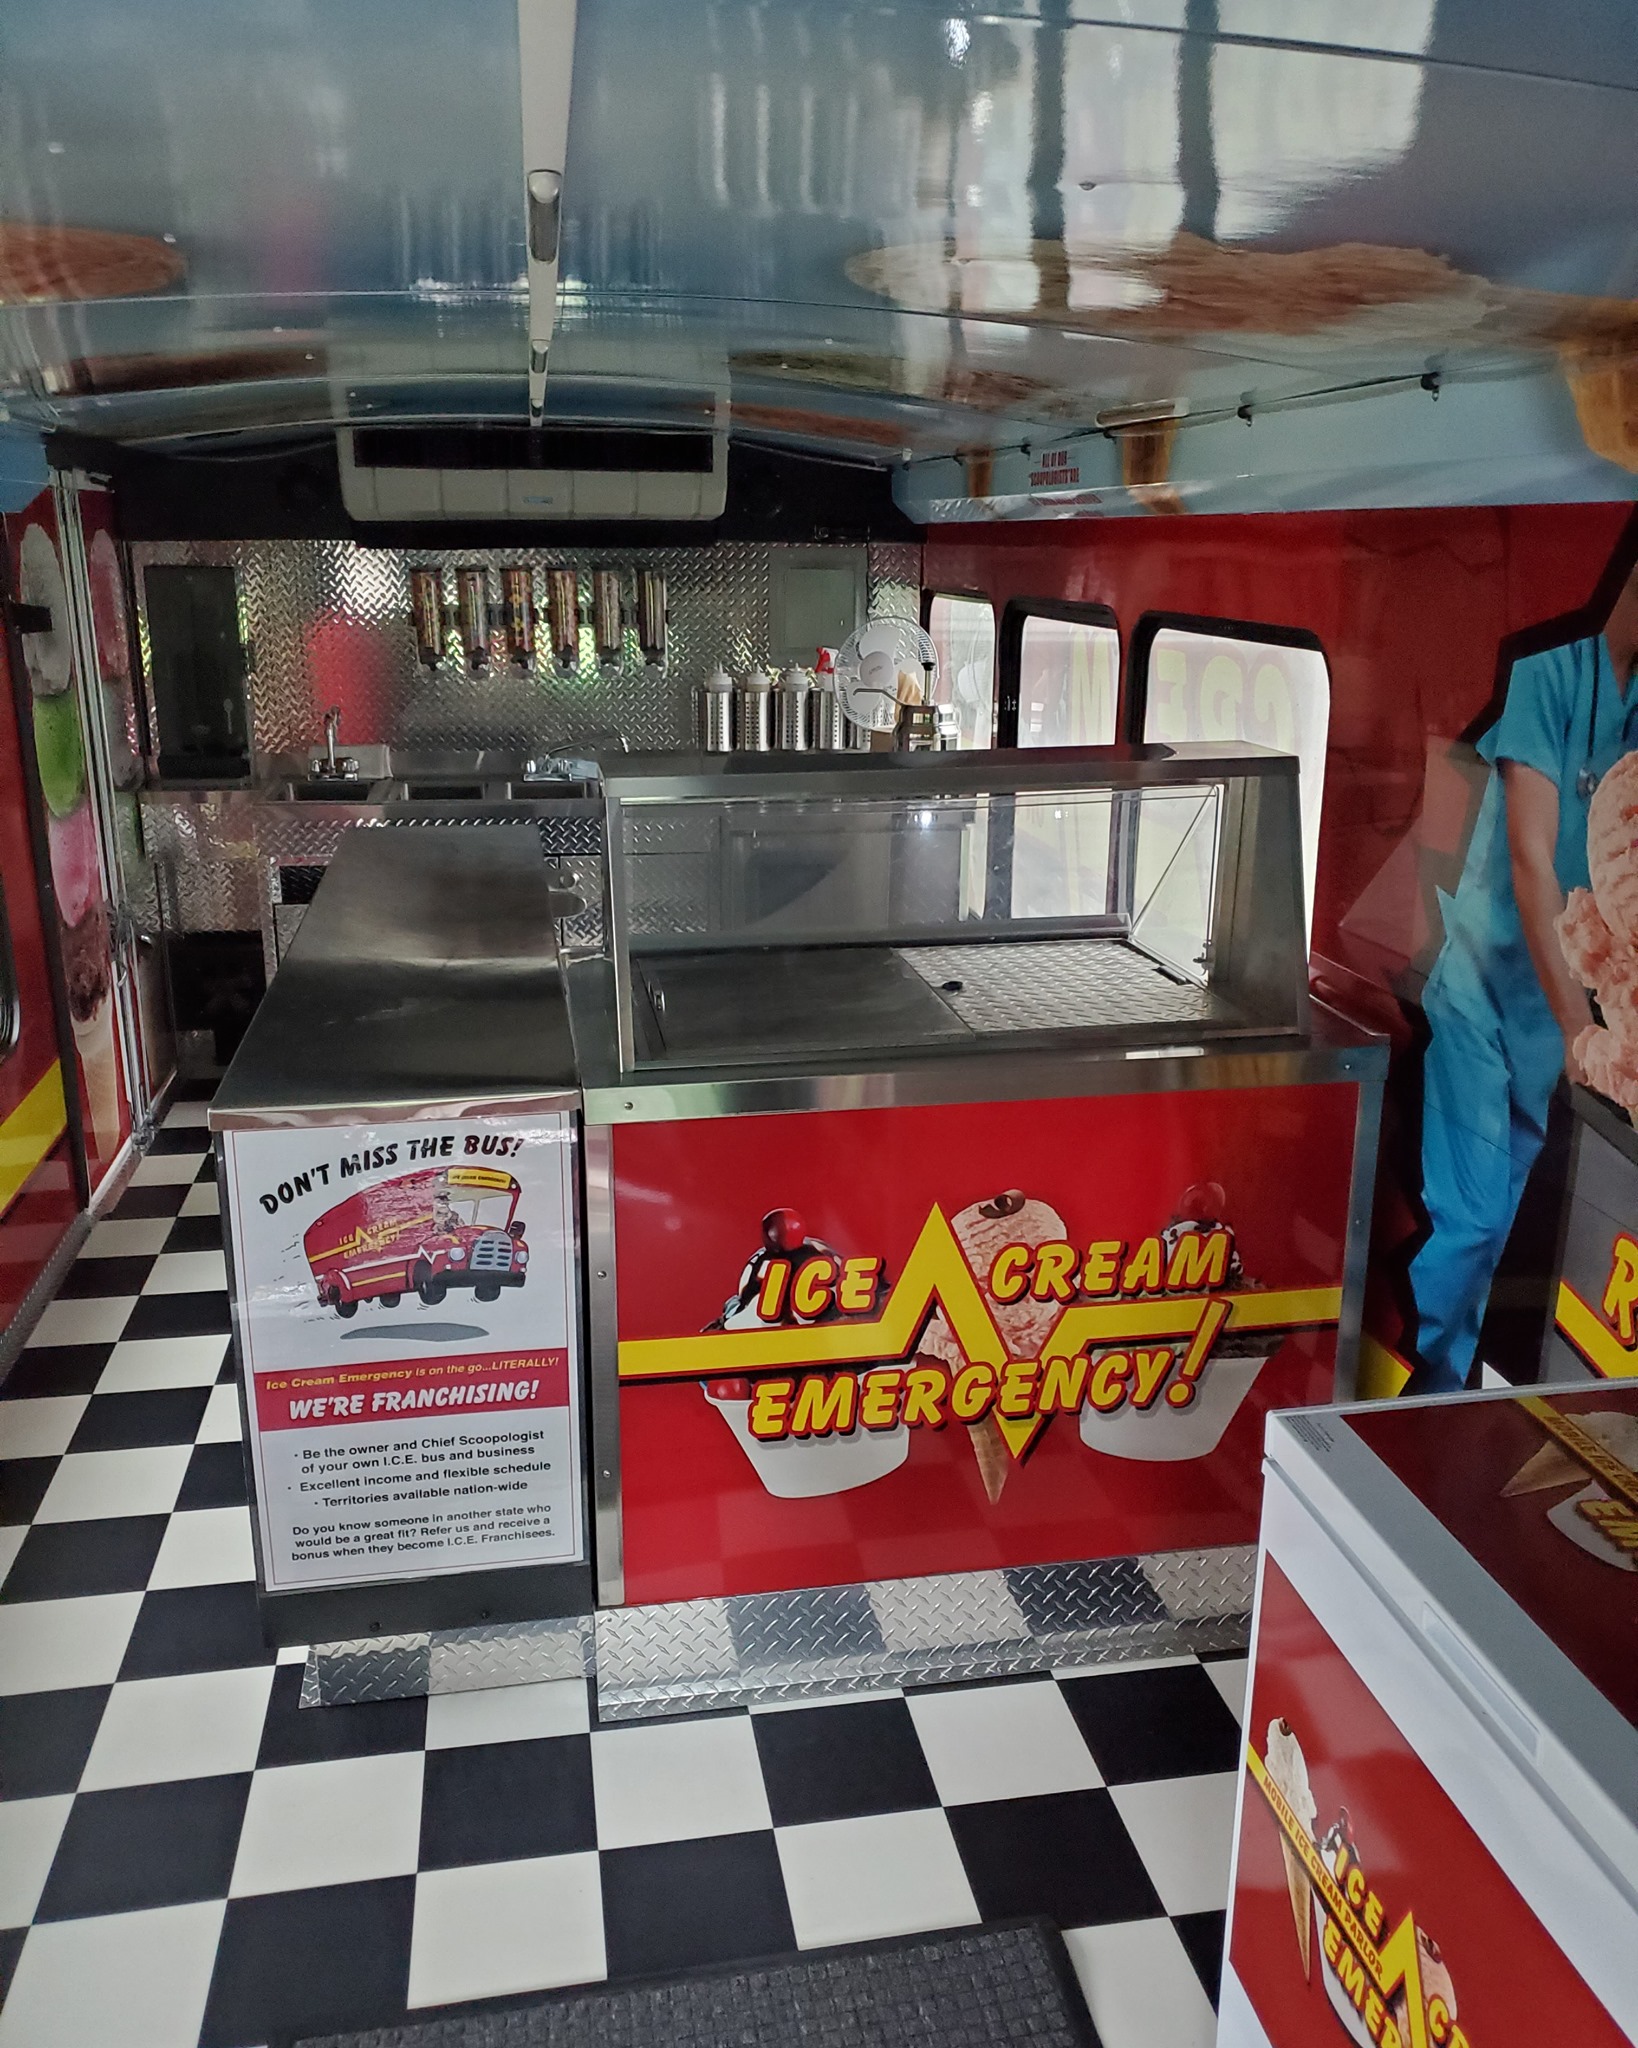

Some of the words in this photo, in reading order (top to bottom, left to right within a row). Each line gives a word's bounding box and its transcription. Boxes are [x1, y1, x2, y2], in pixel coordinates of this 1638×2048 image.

[259, 1164, 330, 1215] DON'T
[340, 1144, 399, 1179] MISS
[407, 1136, 456, 1161] THE
[463, 1135, 526, 1158] BUS!
[756, 1256, 884, 1321] ICE
[987, 1231, 1231, 1304] CREAM
[266, 1381, 288, 1390] Ice
[291, 1376, 334, 1388] Cream
[339, 1369, 412, 1383] Emergency
[415, 1367, 425, 1376] is
[428, 1366, 443, 1375] on
[446, 1364, 465, 1374] the
[467, 1357, 559, 1374] go...LITERALLY!
[749, 1299, 1230, 1437] EMERGENCY!
[289, 1394, 365, 1420] WE'RE
[371, 1380, 540, 1412] FRANCHISING!
[301, 1463, 315, 1474] of
[318, 1462, 348, 1475] your
[352, 1459, 380, 1469] own
[383, 1454, 418, 1466] I.C.E.
[421, 1452, 446, 1463] bus
[449, 1449, 473, 1461] and
[477, 1446, 535, 1459] business
[303, 1449, 321, 1460] Be
[324, 1447, 345, 1458] the
[349, 1444, 389, 1456] owner
[393, 1440, 418, 1452] and
[421, 1436, 456, 1449] Chief
[459, 1430, 544, 1446] Scoopologist
[300, 1478, 361, 1492] Excellent
[364, 1473, 412, 1486] income
[415, 1470, 440, 1481] and
[443, 1466, 490, 1479] flexible
[493, 1461, 551, 1475] schedule
[322, 1493, 389, 1507] Territories
[393, 1487, 450, 1501] available
[453, 1481, 528, 1496] nation-wide
[292, 1526, 309, 1536] Do
[313, 1525, 335, 1535] you
[339, 1520, 371, 1531] know
[374, 1516, 429, 1528] someone
[432, 1514, 443, 1523] in
[446, 1510, 492, 1521] another
[495, 1507, 524, 1517] state
[526, 1504, 551, 1514] who
[295, 1536, 332, 1548] would
[335, 1535, 350, 1544] be
[353, 1535, 361, 1543] a
[363, 1531, 394, 1543] great
[397, 1528, 416, 1539] fit?
[420, 1525, 452, 1536] Refer
[455, 1524, 470, 1533] us
[473, 1521, 495, 1531] and
[498, 1517, 541, 1529] receive
[543, 1517, 551, 1525] a
[291, 1550, 330, 1561] bonus
[332, 1546, 365, 1557] when
[368, 1544, 394, 1555] they
[397, 1539, 444, 1551] become
[447, 1535, 478, 1546] I.C.E.
[481, 1529, 555, 1543] Franchisees.
[1263, 1776, 1294, 1830] MOBILE
[1295, 1828, 1310, 1857] ICE
[1311, 1858, 1342, 1913] CREAM
[1344, 1911, 1384, 1980] PARLOR
[1334, 1845, 1385, 1938] ICE
